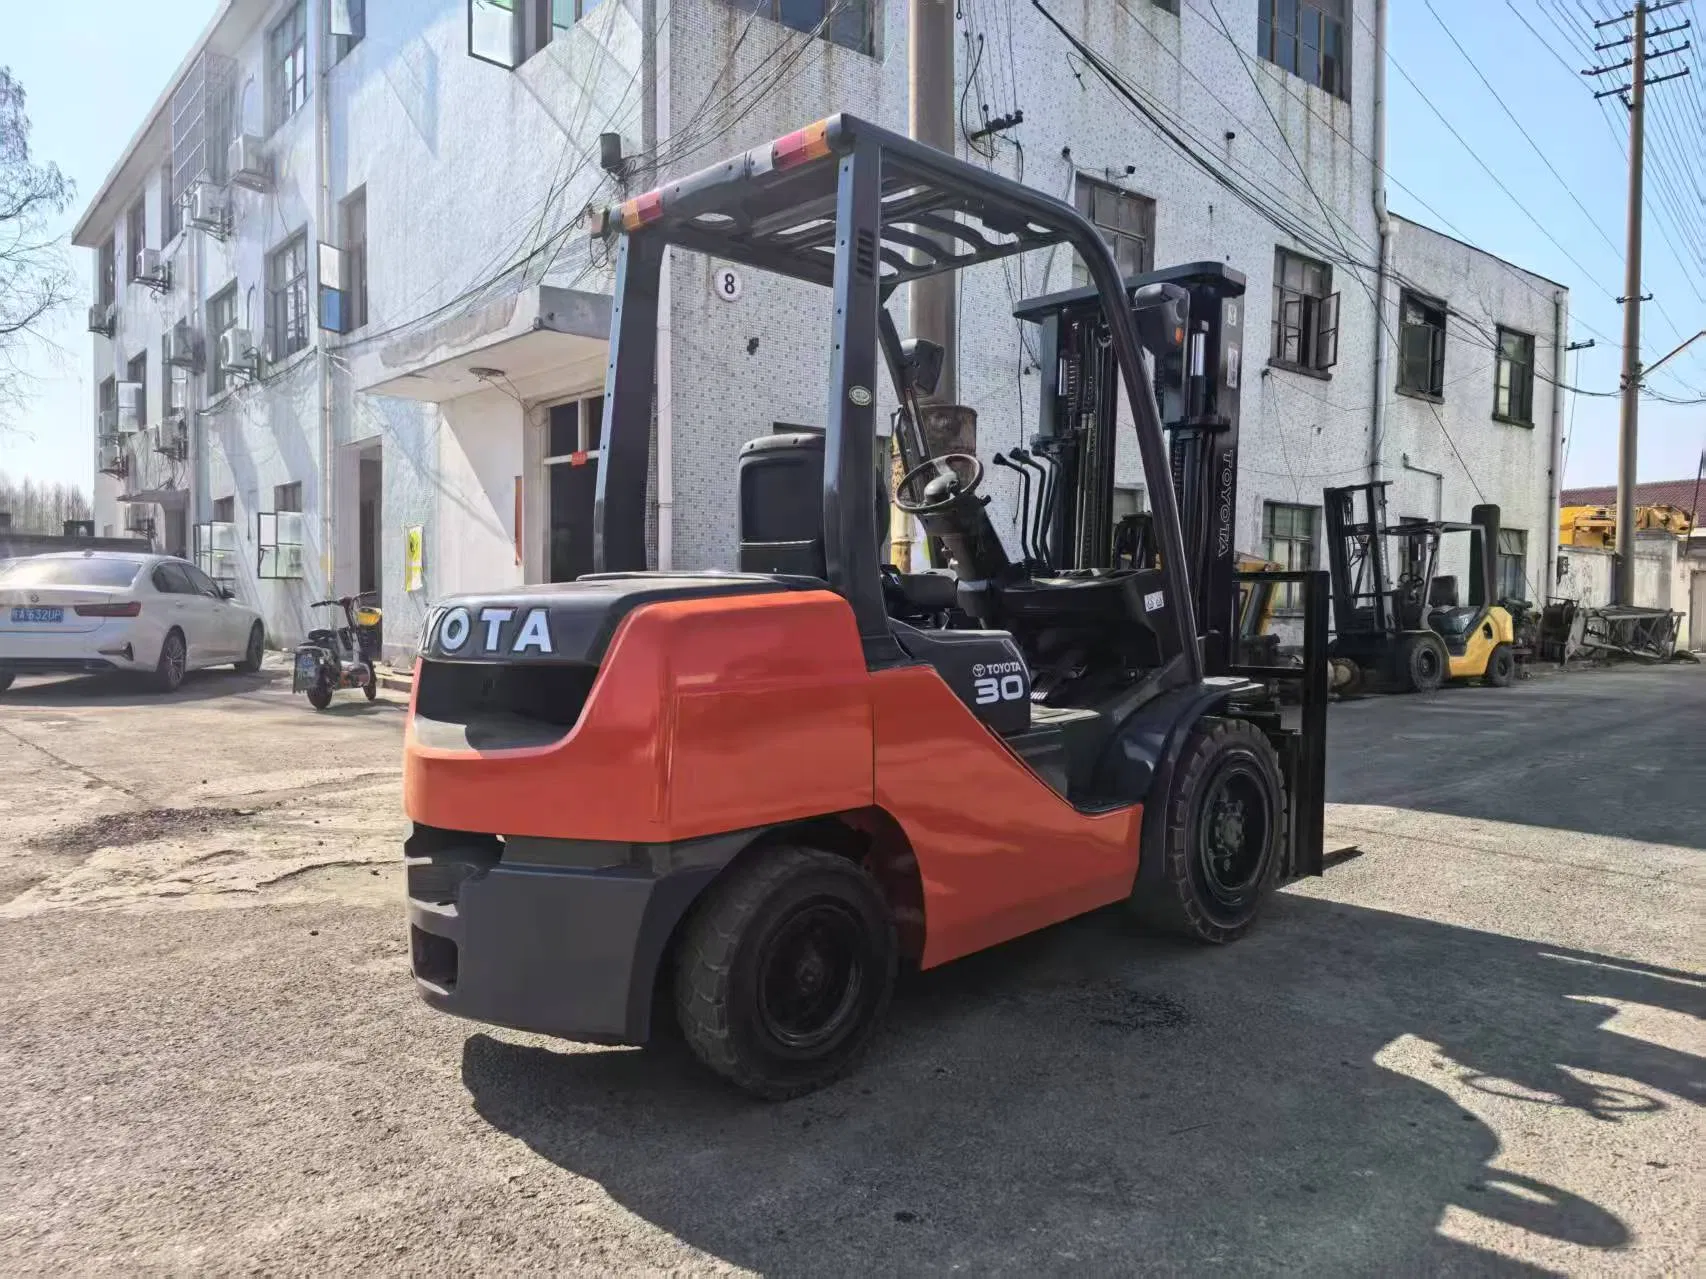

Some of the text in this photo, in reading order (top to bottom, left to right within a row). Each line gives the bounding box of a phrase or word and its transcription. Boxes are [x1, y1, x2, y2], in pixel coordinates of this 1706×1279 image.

[725, 273, 735, 294] 8
[1219, 449, 1234, 557] TOYOTA
[986, 661, 1022, 674] TOYOTA
[974, 674, 1023, 704] 30
